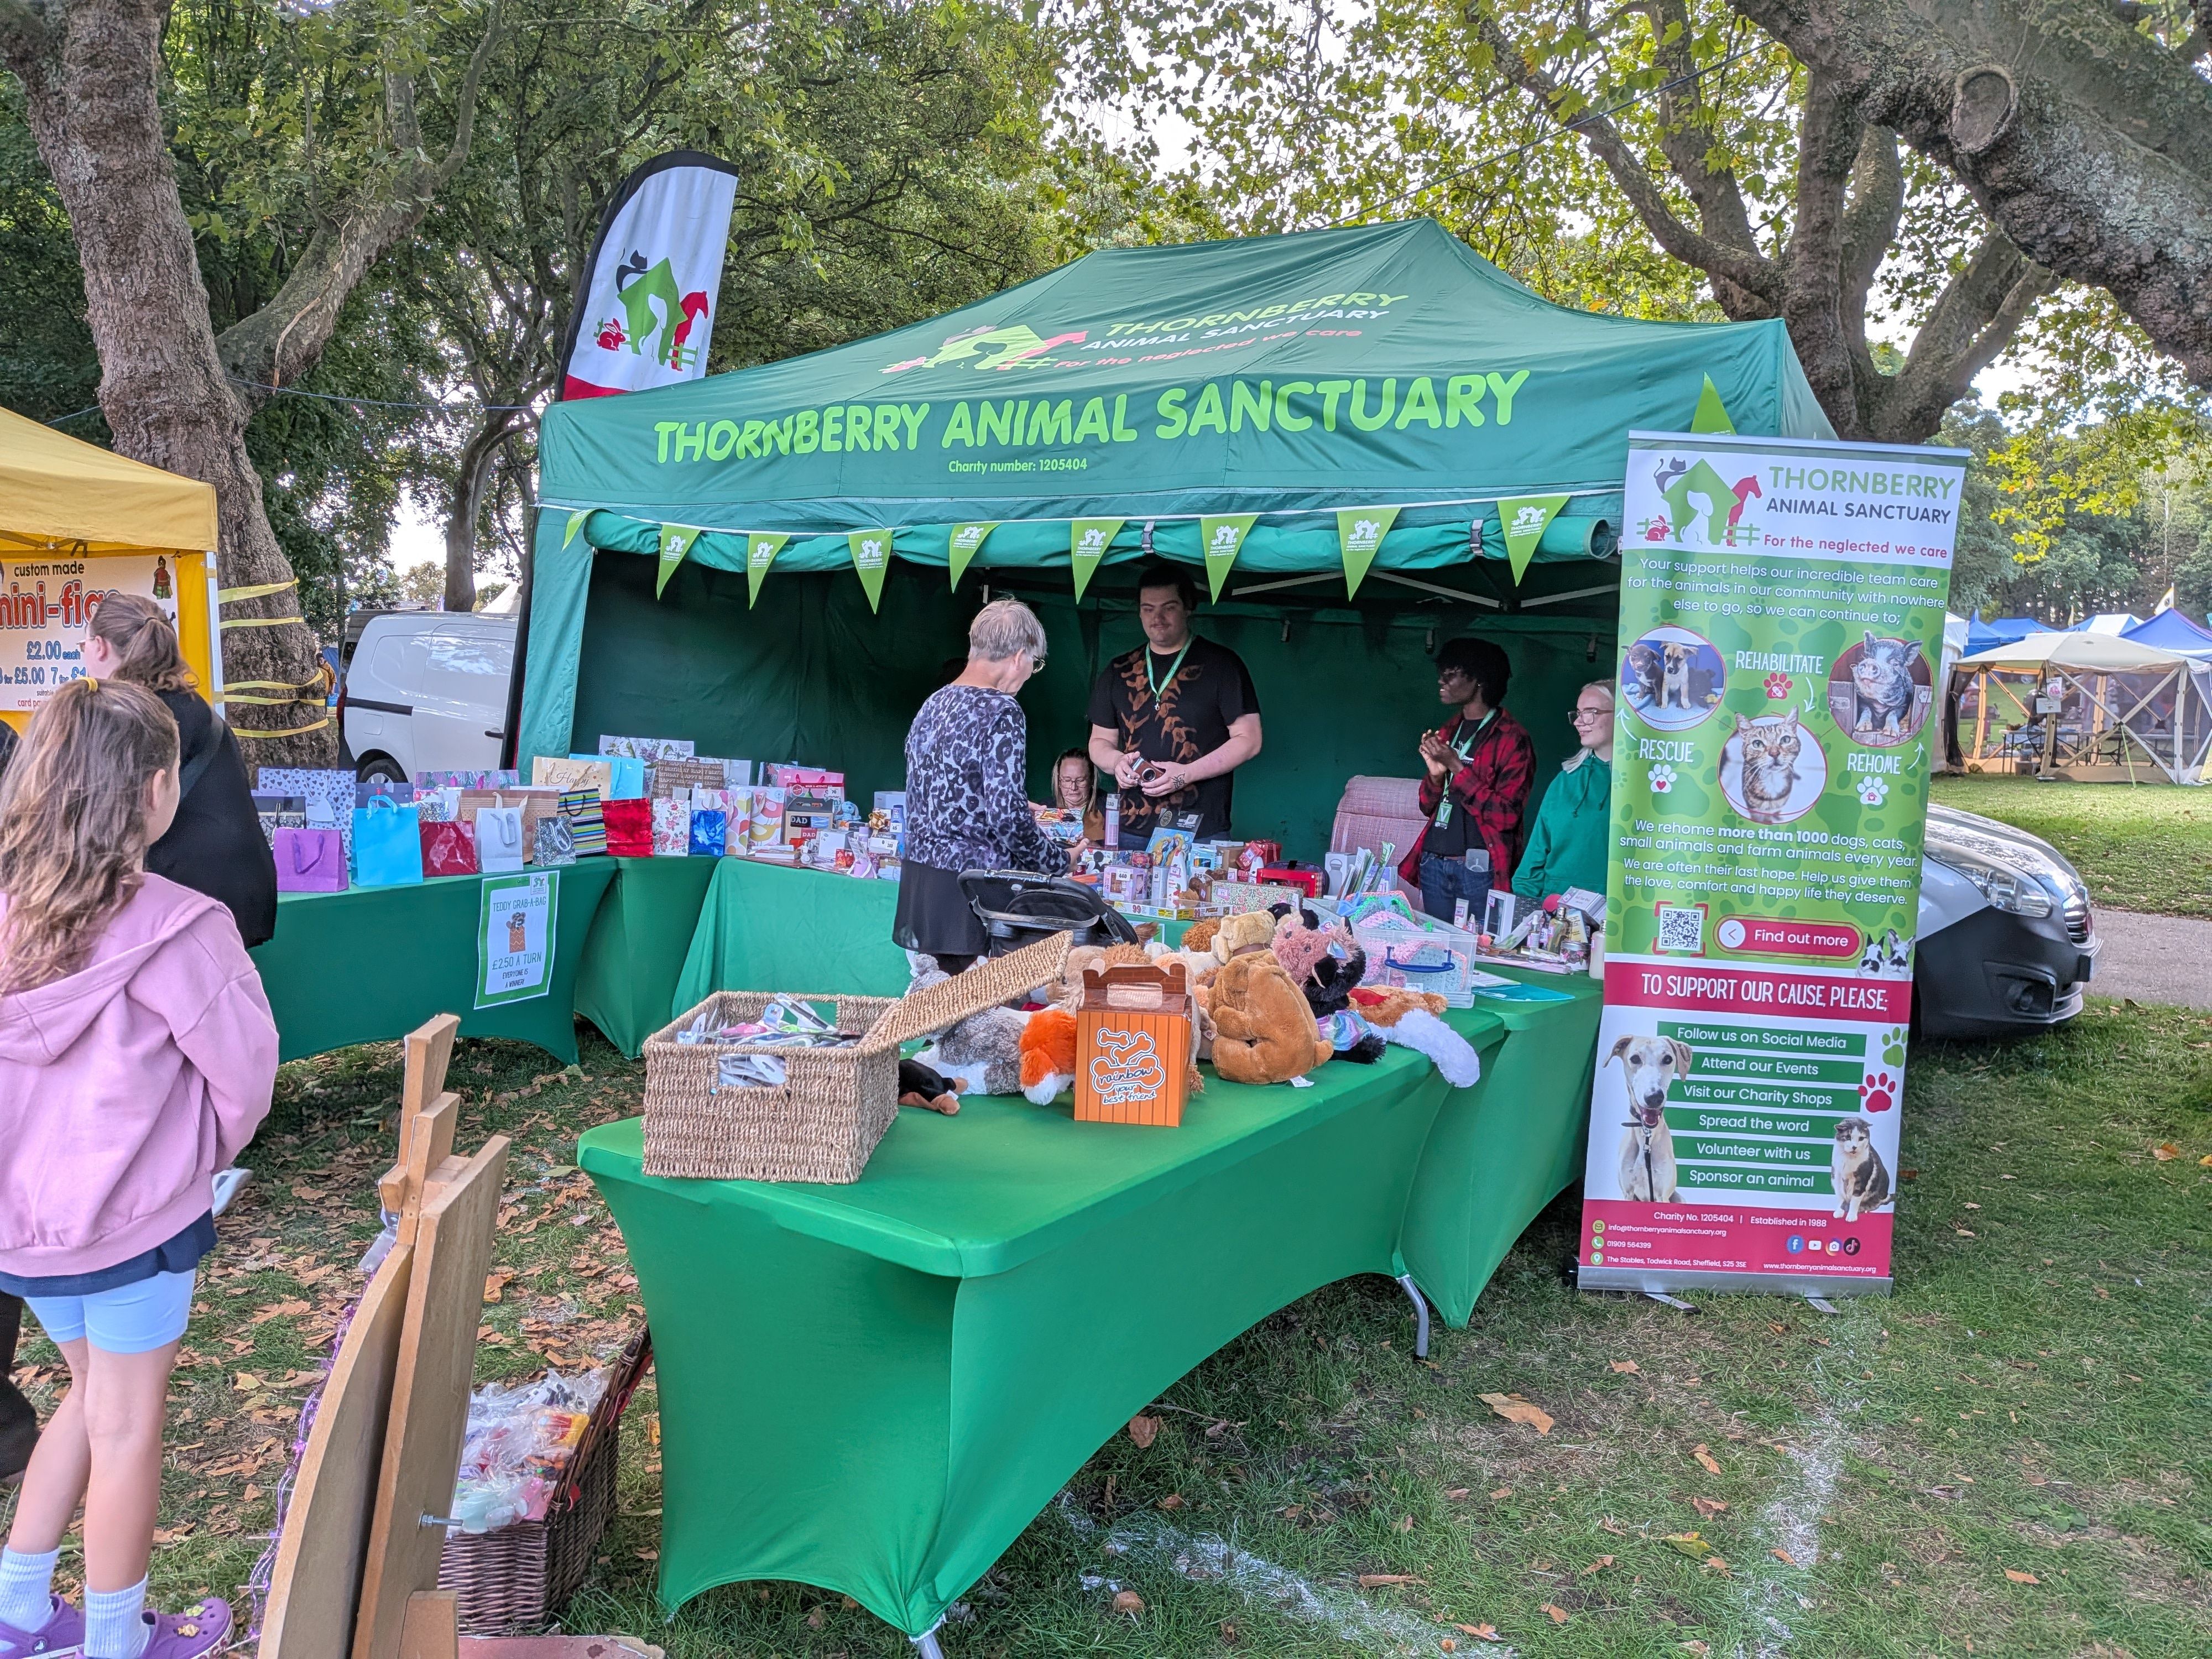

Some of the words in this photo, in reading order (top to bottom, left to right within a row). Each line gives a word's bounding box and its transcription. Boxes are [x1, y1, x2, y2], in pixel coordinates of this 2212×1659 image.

[1107, 292, 1409, 336] THORNBERRY
[1081, 327, 1192, 351] ANIMAL
[1203, 310, 1390, 340] SANCTUARY
[1054, 359, 1091, 369] For
[1095, 355, 1132, 366] the
[1138, 338, 1254, 361] neglected
[1262, 333, 1298, 342] we
[1307, 329, 1361, 338] care
[654, 402, 930, 464] THORNBERRY
[942, 393, 1138, 449] ANIMAL
[1155, 370, 1531, 440] SANCTUARY
[948, 459, 988, 474] Charity
[990, 461, 1036, 473] number:
[1039, 458, 1087, 471] 1205404
[1768, 466, 1955, 500] THORNBERRY
[1766, 498, 1839, 517] ANIMAL
[1844, 502, 1951, 525] SANCTUARY
[1764, 535, 1786, 547] For
[1790, 536, 1814, 548] the
[1819, 538, 1889, 554] neglected
[1895, 544, 1916, 555] we
[1920, 546, 1947, 559] care
[14, 562, 49, 577] custom
[53, 562, 85, 575] made
[1640, 558, 1671, 571] Your
[1674, 560, 1726, 576] support
[1730, 562, 1767, 578] helps
[1771, 567, 1793, 580] our
[1797, 566, 1864, 584] incredible
[1869, 573, 1906, 586] team
[1910, 577, 1938, 589] care
[1627, 576, 1647, 588] for
[1651, 577, 1672, 589] the
[1675, 579, 1729, 594] animals
[1734, 582, 1745, 595] in
[1750, 585, 1771, 597] our
[1775, 585, 1854, 605] community
[1857, 590, 1886, 604] with
[1891, 593, 1945, 609] nowhere
[1674, 599, 1699, 612] else
[1704, 600, 1717, 612] to
[1721, 604, 1743, 616] go,
[1746, 603, 1761, 614] so
[1765, 605, 1785, 616] we
[1789, 607, 1815, 618] can
[1821, 606, 1879, 623] continue
[1882, 611, 1901, 625] to;
[27, 641, 61, 660] £2.00
[62, 649, 80, 659] each
[1736, 650, 1824, 675] REHABILITATE
[14, 667, 45, 685] £5.00
[51, 667, 58, 684] 7
[1640, 738, 1694, 763] RESCUE
[1848, 753, 1902, 775] REHOME
[550, 772, 590, 788] Happy
[1440, 807, 1450, 822] V
[1635, 820, 1654, 832] We
[1658, 822, 1714, 836] rehome
[1718, 826, 1755, 839] more
[1757, 827, 1793, 842] than
[1796, 830, 1828, 844] 1000
[1832, 833, 1868, 849] dogs,
[1872, 838, 1906, 852] cats,
[1619, 836, 1652, 849] small
[1655, 838, 1713, 853] animals
[1717, 841, 1743, 854] and
[1747, 844, 1781, 858] farm
[1786, 847, 1840, 862] animals
[1845, 852, 1883, 868] every
[1888, 855, 1917, 869] year.
[1624, 858, 1639, 869] We
[1643, 860, 1663, 871] are
[1667, 860, 1701, 873] often
[1704, 862, 1732, 875] their
[1735, 865, 1757, 878] last
[1761, 867, 1797, 881] hope.
[1801, 871, 1828, 885] Help
[1832, 874, 1845, 884] us
[1849, 873, 1876, 888] give
[1880, 876, 1911, 888] them
[1625, 875, 1641, 886] the
[1645, 875, 1673, 890] love,
[1677, 878, 1727, 893] comfort
[1730, 881, 1755, 894] and
[1759, 884, 1801, 900] happy
[1804, 885, 1822, 899] life
[1825, 888, 1852, 903] they
[1855, 891, 1907, 905] deserve.
[493, 901, 512, 912] TEDDY
[513, 896, 546, 909] GRAB-A-BAG
[1754, 930, 1785, 942] Find
[1790, 932, 1809, 944] out
[1813, 935, 1848, 947] more
[492, 957, 513, 969] £2.50
[516, 956, 519, 966] A
[523, 952, 541, 964] TURN
[503, 969, 524, 979] EVERYONE
[1641, 973, 1661, 995] TO
[1667, 975, 1738, 1000] SUPPORT
[1741, 980, 1772, 1003] OUR
[1778, 983, 1825, 1008] CAUSE,
[1830, 987, 1888, 1012] PLEASE;
[1677, 1027, 1718, 1041] Follow
[1721, 1032, 1736, 1041] us
[1741, 1032, 1758, 1042] on
[1762, 1032, 1802, 1047] Social
[1807, 1035, 1846, 1049] Media
[1702, 1057, 1745, 1071] Attend
[1750, 1062, 1772, 1072] our
[1776, 1062, 1818, 1075] Events
[1099, 1067, 1152, 1084] rainbow
[1103, 1094, 1124, 1104] best
[1128, 1091, 1156, 1102] friend
[1114, 1084, 1136, 1097] your
[1684, 1085, 1710, 1098] Visit
[1714, 1089, 1735, 1099] our
[1739, 1088, 1788, 1105] Charity
[1792, 1092, 1832, 1107] Shops
[1699, 1115, 1747, 1130] Spread
[1751, 1117, 1772, 1130] the
[1776, 1119, 1809, 1132] word
[1697, 1142, 1761, 1157] Volunteer
[1765, 1146, 1792, 1159] with
[1793, 1150, 1810, 1160] us
[1689, 1170, 1743, 1185] Sponsor
[1747, 1175, 1764, 1185] an
[1768, 1174, 1814, 1188] animal
[1653, 1212, 1684, 1223] Charity
[1686, 1213, 1699, 1222] No.
[1700, 1214, 1734, 1223] 1205404
[1750, 1217, 1797, 1226] Established
[1799, 1218, 1807, 1227] in
[1808, 1218, 1827, 1227] 1988
[1608, 1224, 1726, 1237] info@thornberryanimalsanctuary.org
[1620, 1256, 1645, 1265] Stables,
[1692, 1259, 1721, 1268] Sheffield,
[1764, 1262, 1876, 1274] www.thornberryanimalsanctuary.org
